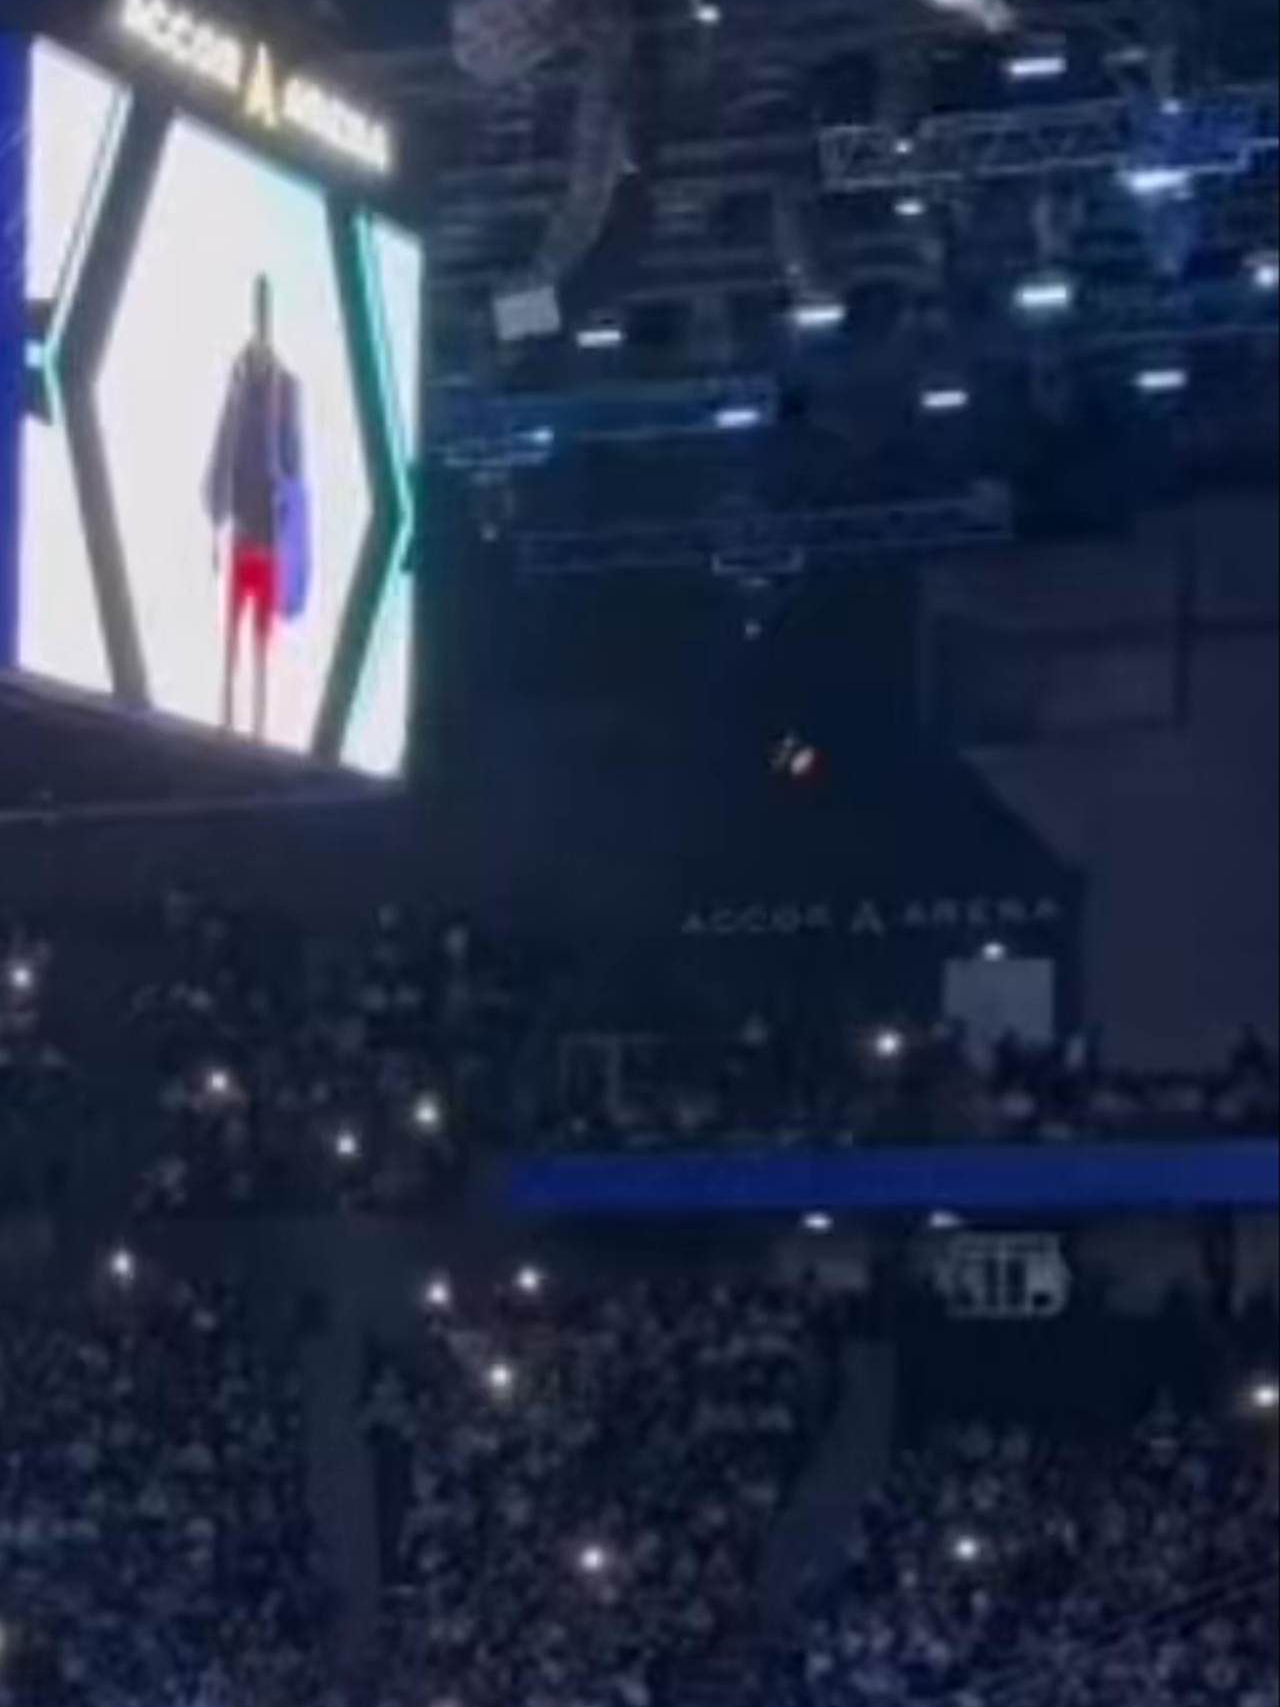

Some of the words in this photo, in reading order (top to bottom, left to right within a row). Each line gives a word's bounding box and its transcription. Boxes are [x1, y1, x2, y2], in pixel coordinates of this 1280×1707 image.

[283, 76, 390, 172] ARENA
[681, 902, 834, 936] ACCOR
[903, 897, 1062, 928] ARENA
